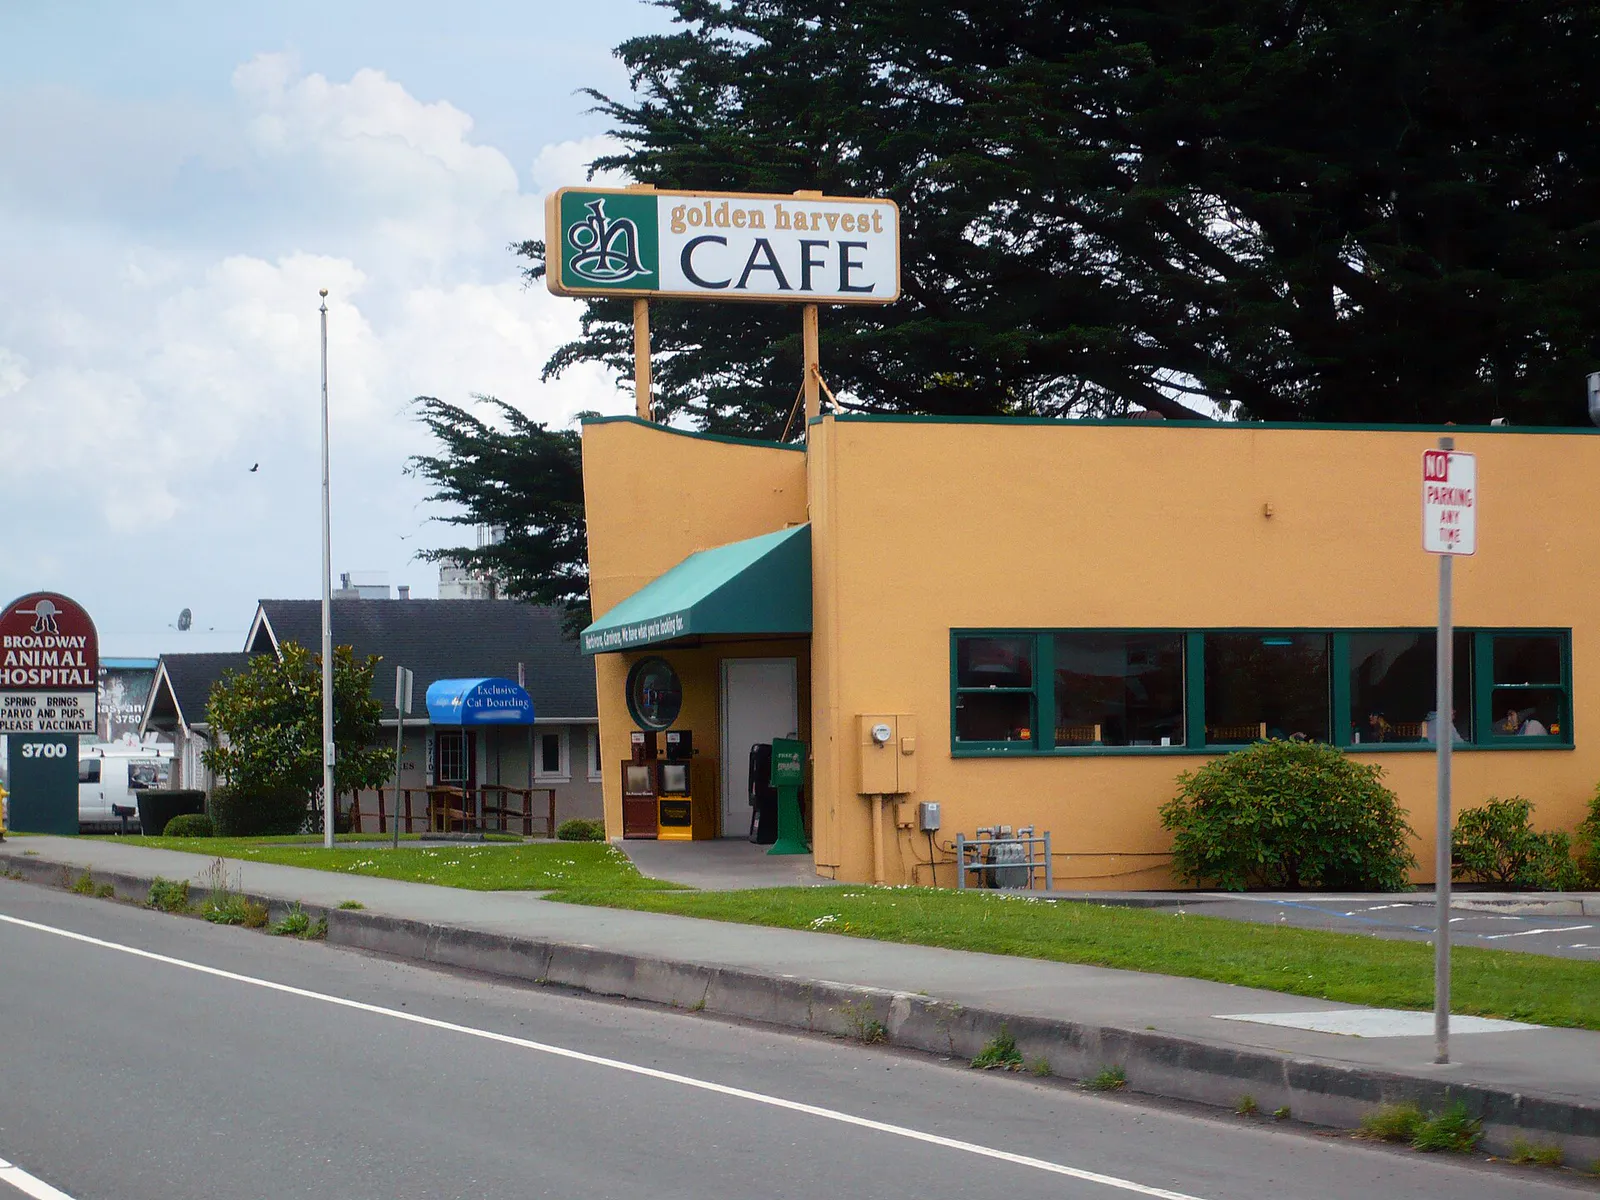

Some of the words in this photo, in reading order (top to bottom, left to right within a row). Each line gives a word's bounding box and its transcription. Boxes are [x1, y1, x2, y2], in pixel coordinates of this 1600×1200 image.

[670, 200, 766, 235] golden
[773, 204, 884, 234] harvest
[680, 234, 877, 293] CAFE
[1425, 454, 1446, 478] NO
[1427, 486, 1472, 507] PARKING
[1440, 510, 1460, 524] ANY
[1440, 527, 1460, 543] TIME
[638, 623, 648, 638] what
[648, 621, 660, 641] you're
[660, 616, 676, 635] looking
[3, 635, 87, 648] BROADWAY
[3, 650, 87, 667] ANIMAL
[0, 668, 94, 685] HOSPITAL
[477, 685, 518, 695] Exclusive
[4, 697, 36, 707] SPRING
[47, 697, 78, 707] BRINGS
[466, 698, 482, 707] Cat
[486, 697, 529, 710] Boarding
[0, 709, 32, 719] PARVO
[37, 709, 56, 719] AND
[61, 709, 85, 719] PUPS
[115, 715, 141, 724] 3750
[0, 720, 33, 730] PLEASE
[39, 720, 93, 730] VACCINATE
[22, 743, 68, 758] 3700
